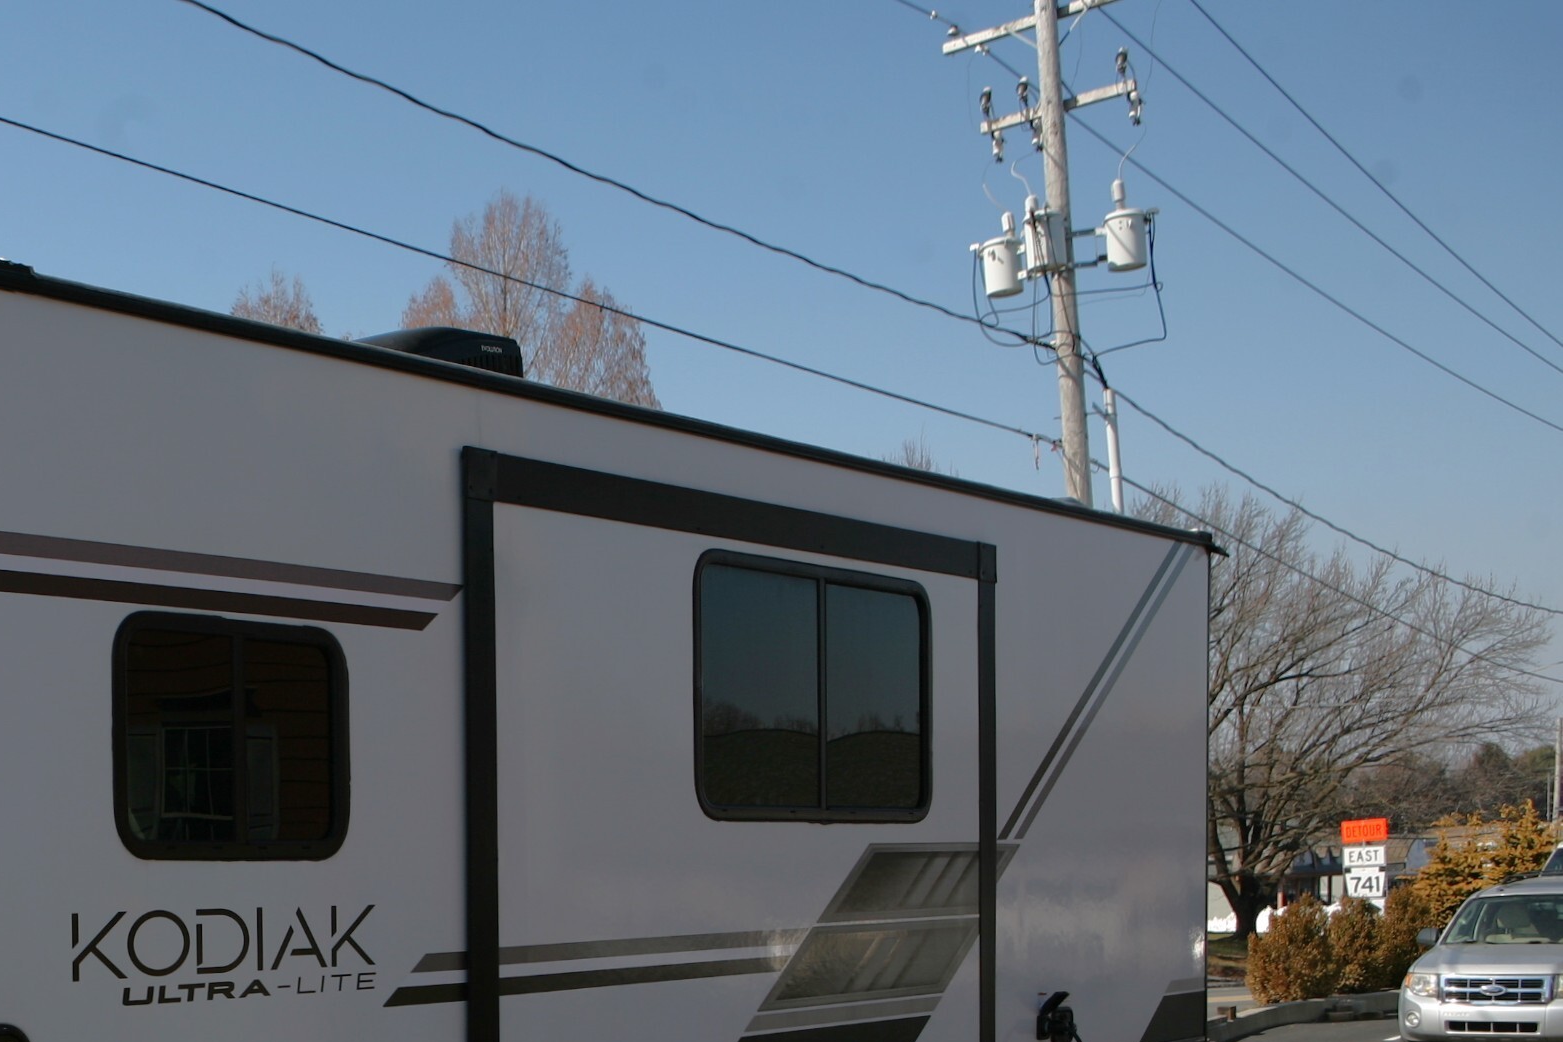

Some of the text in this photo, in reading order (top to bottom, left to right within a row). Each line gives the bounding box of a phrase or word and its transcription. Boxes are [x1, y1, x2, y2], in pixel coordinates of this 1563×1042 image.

[1345, 824, 1382, 839] DETOUR
[1348, 849, 1380, 863] EAST
[1349, 875, 1381, 894] 741
[71, 904, 376, 982] KODIAK
[121, 972, 377, 1006] ULTRA-LITE
